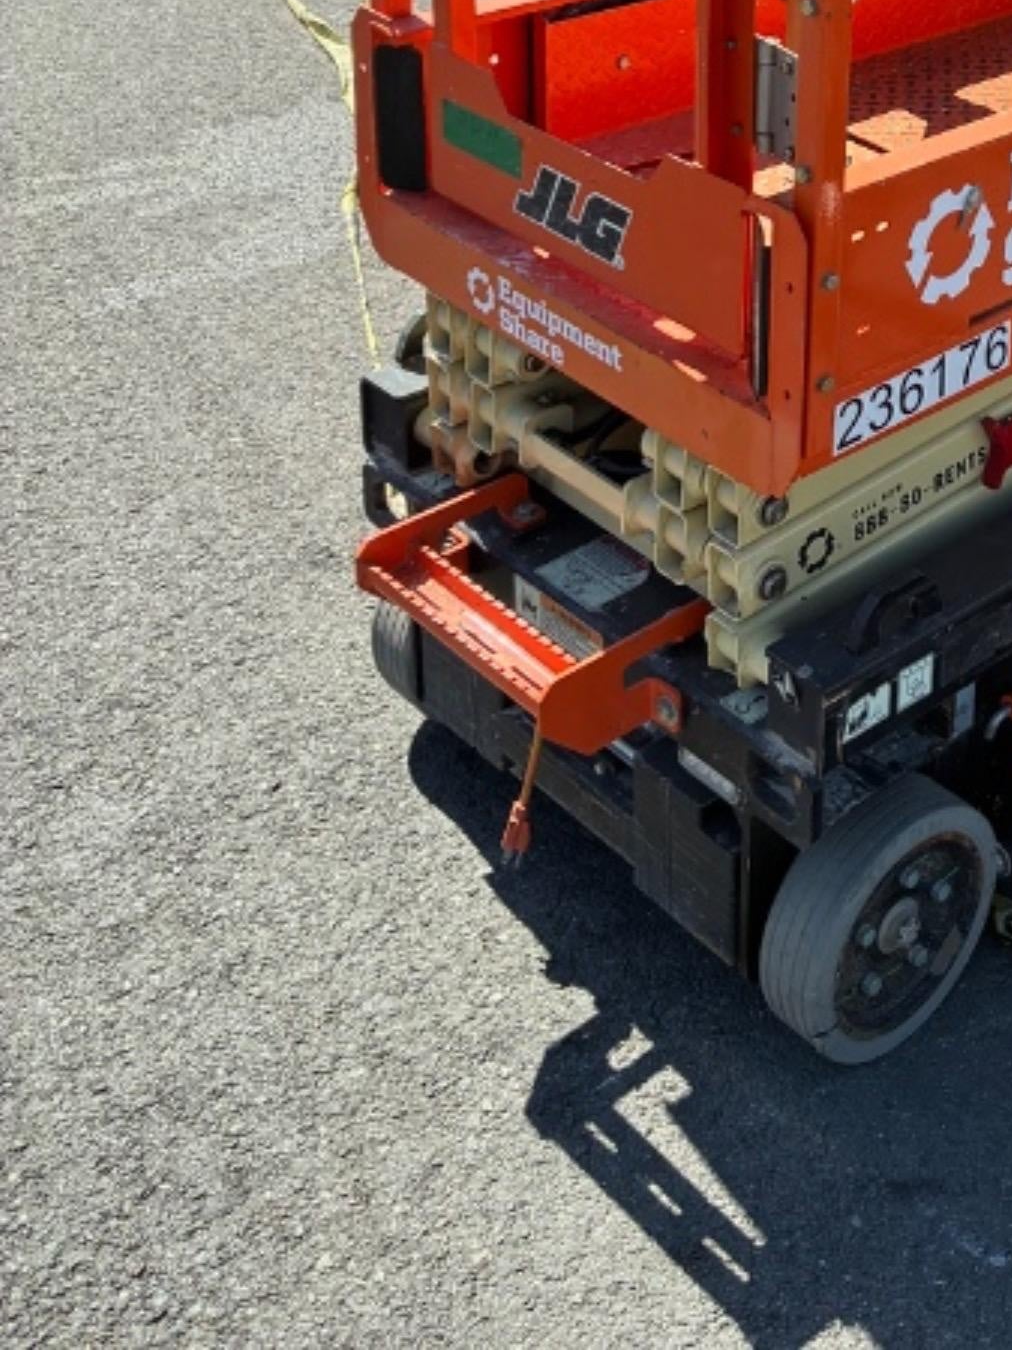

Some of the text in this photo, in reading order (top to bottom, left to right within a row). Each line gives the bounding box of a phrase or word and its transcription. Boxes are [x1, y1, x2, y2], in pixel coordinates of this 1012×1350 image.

[513, 164, 634, 264] JLG
[497, 275, 623, 372] Equipment
[500, 307, 565, 366] Share
[837, 326, 1008, 450] 236176
